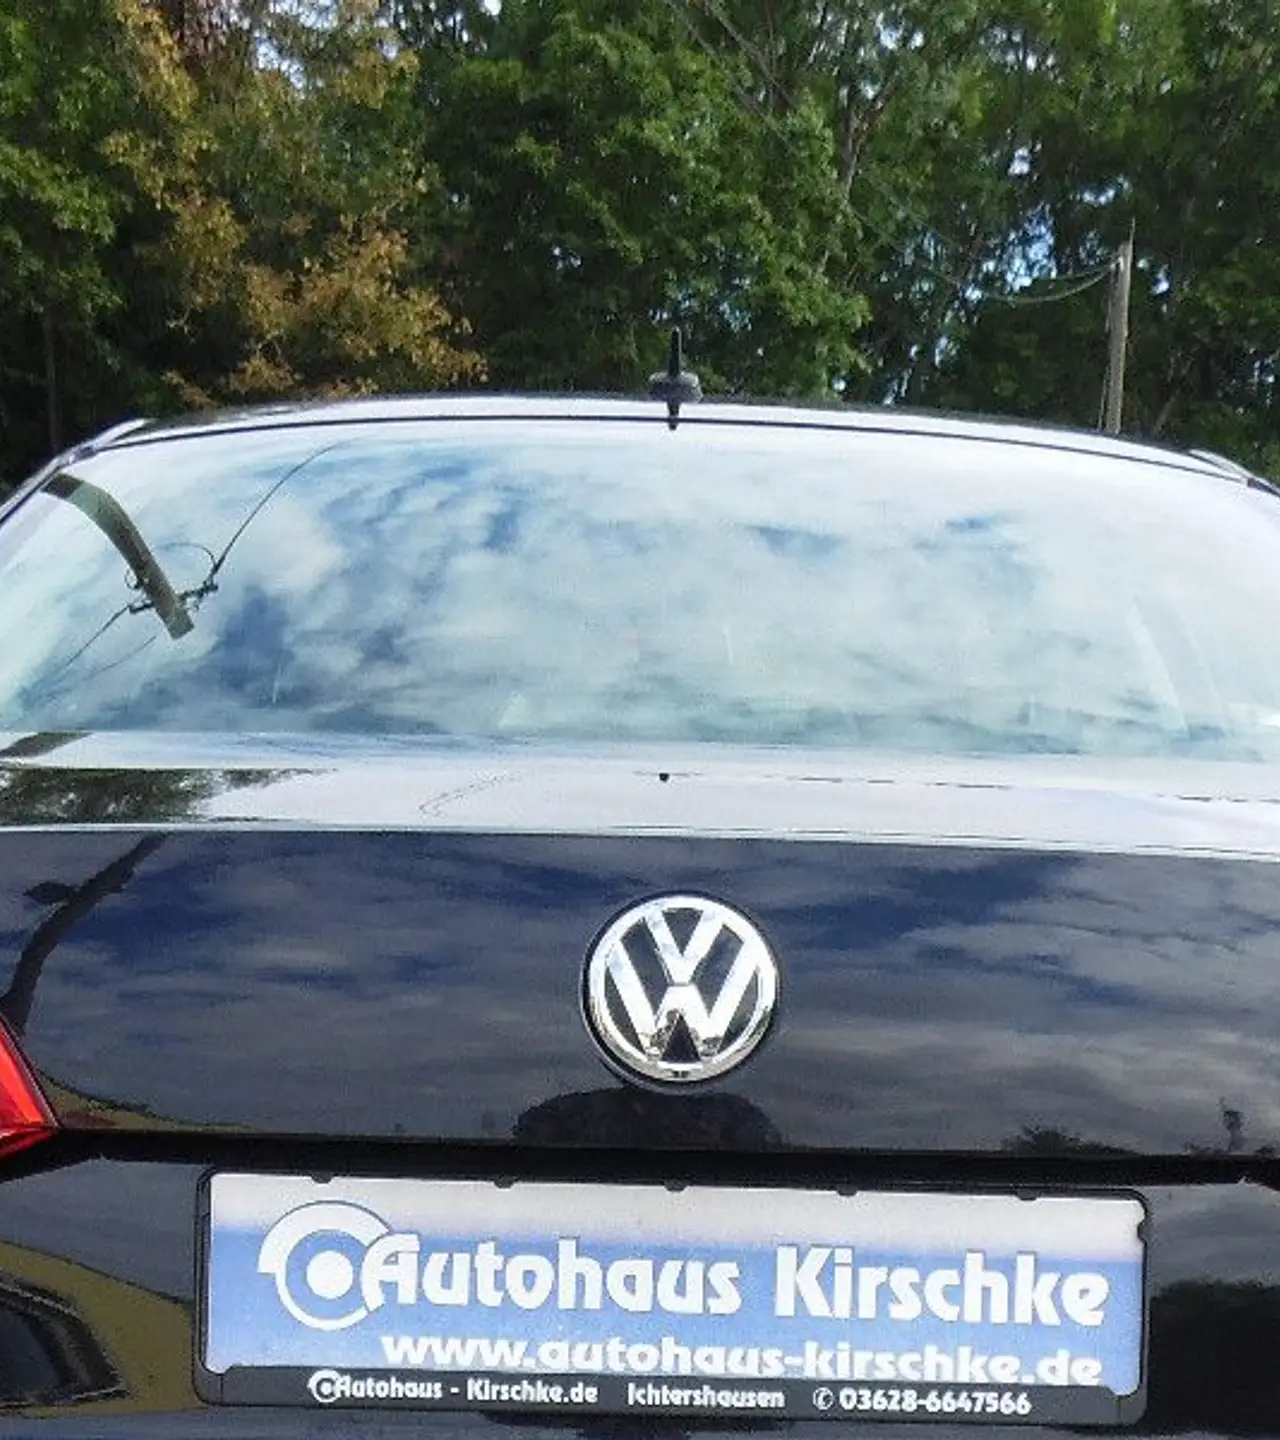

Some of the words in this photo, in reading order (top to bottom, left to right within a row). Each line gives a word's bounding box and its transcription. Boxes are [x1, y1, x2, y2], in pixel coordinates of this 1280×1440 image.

[592, 897, 774, 1074] VW
[361, 1233, 743, 1316] Autohaus
[774, 1244, 1110, 1327] Kirschke
[334, 1374, 443, 1400] Autohaus
[466, 1377, 599, 1404] Kirschke.de
[627, 1382, 785, 1409] Ichtershausen
[839, 1386, 1032, 1416] 03628-6647566
[380, 1335, 1104, 1386] www.autohaus-kirschke.de
